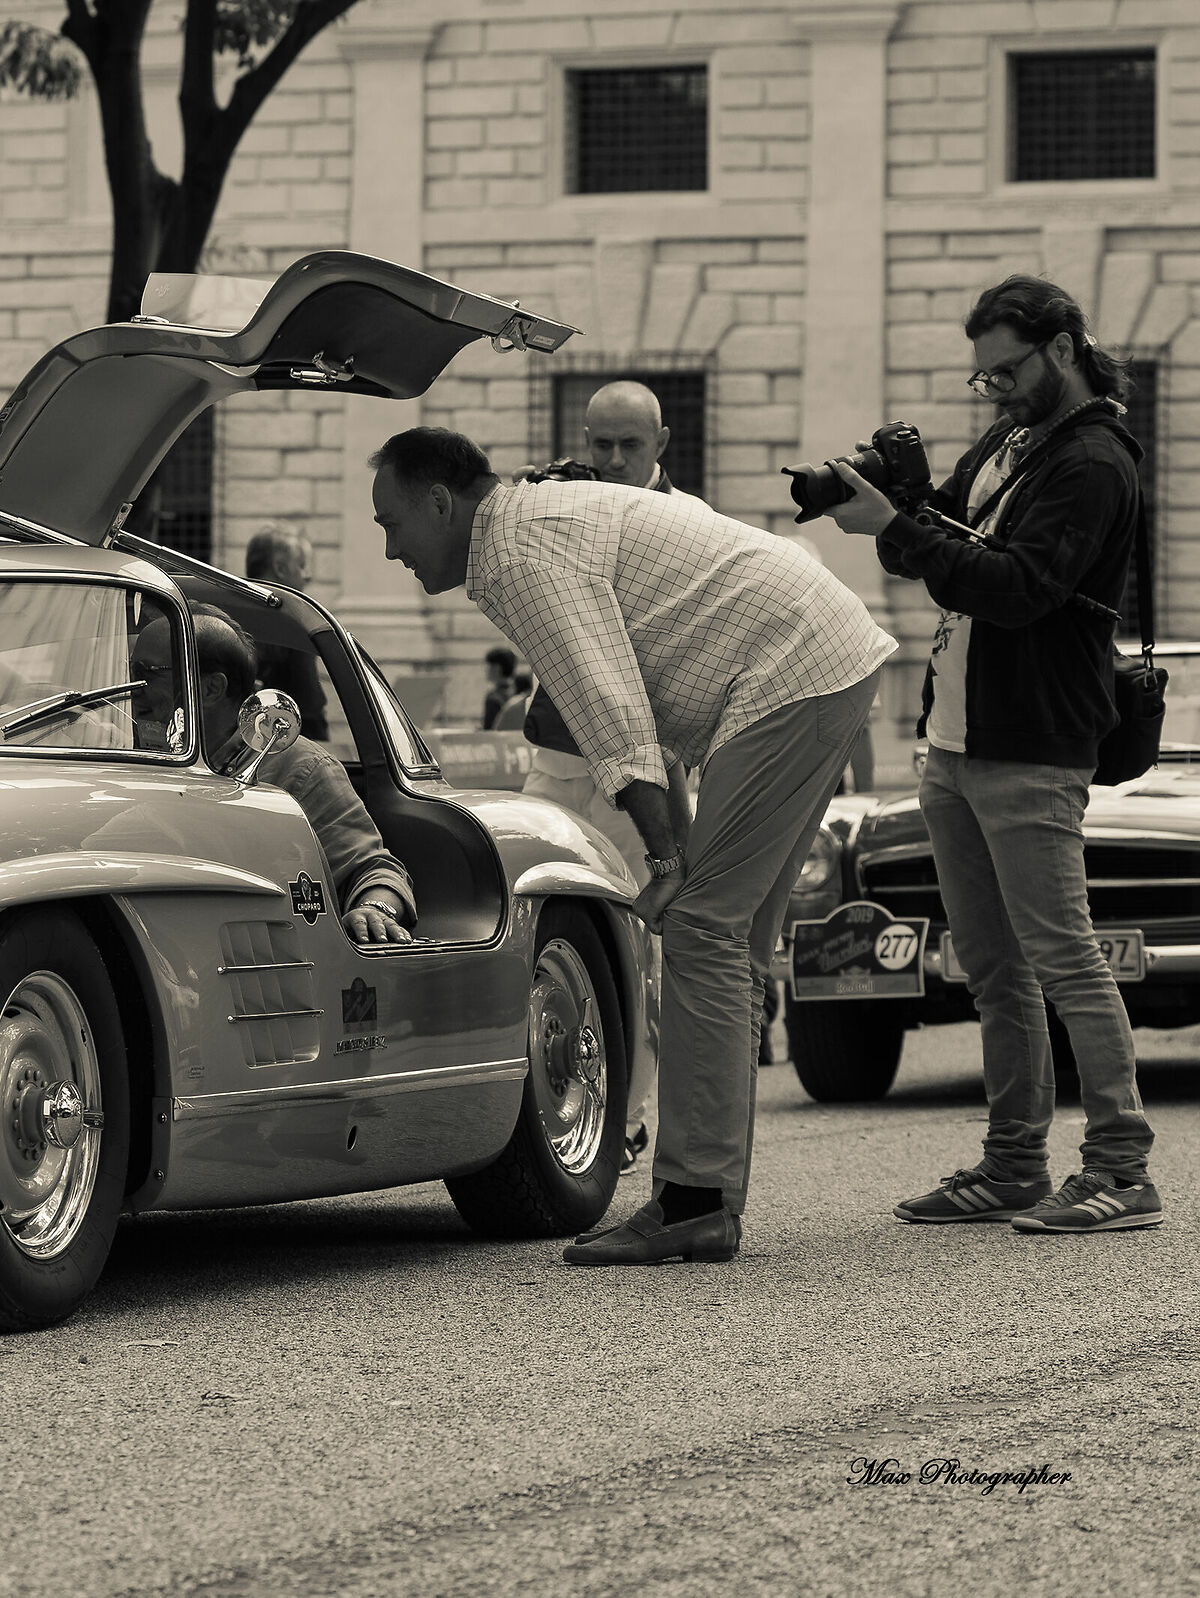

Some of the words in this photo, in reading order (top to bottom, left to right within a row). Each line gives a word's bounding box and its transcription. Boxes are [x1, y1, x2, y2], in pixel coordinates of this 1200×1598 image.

[845, 907, 875, 924] 2019
[879, 934, 916, 960] 277
[1100, 939, 1130, 963] 97
